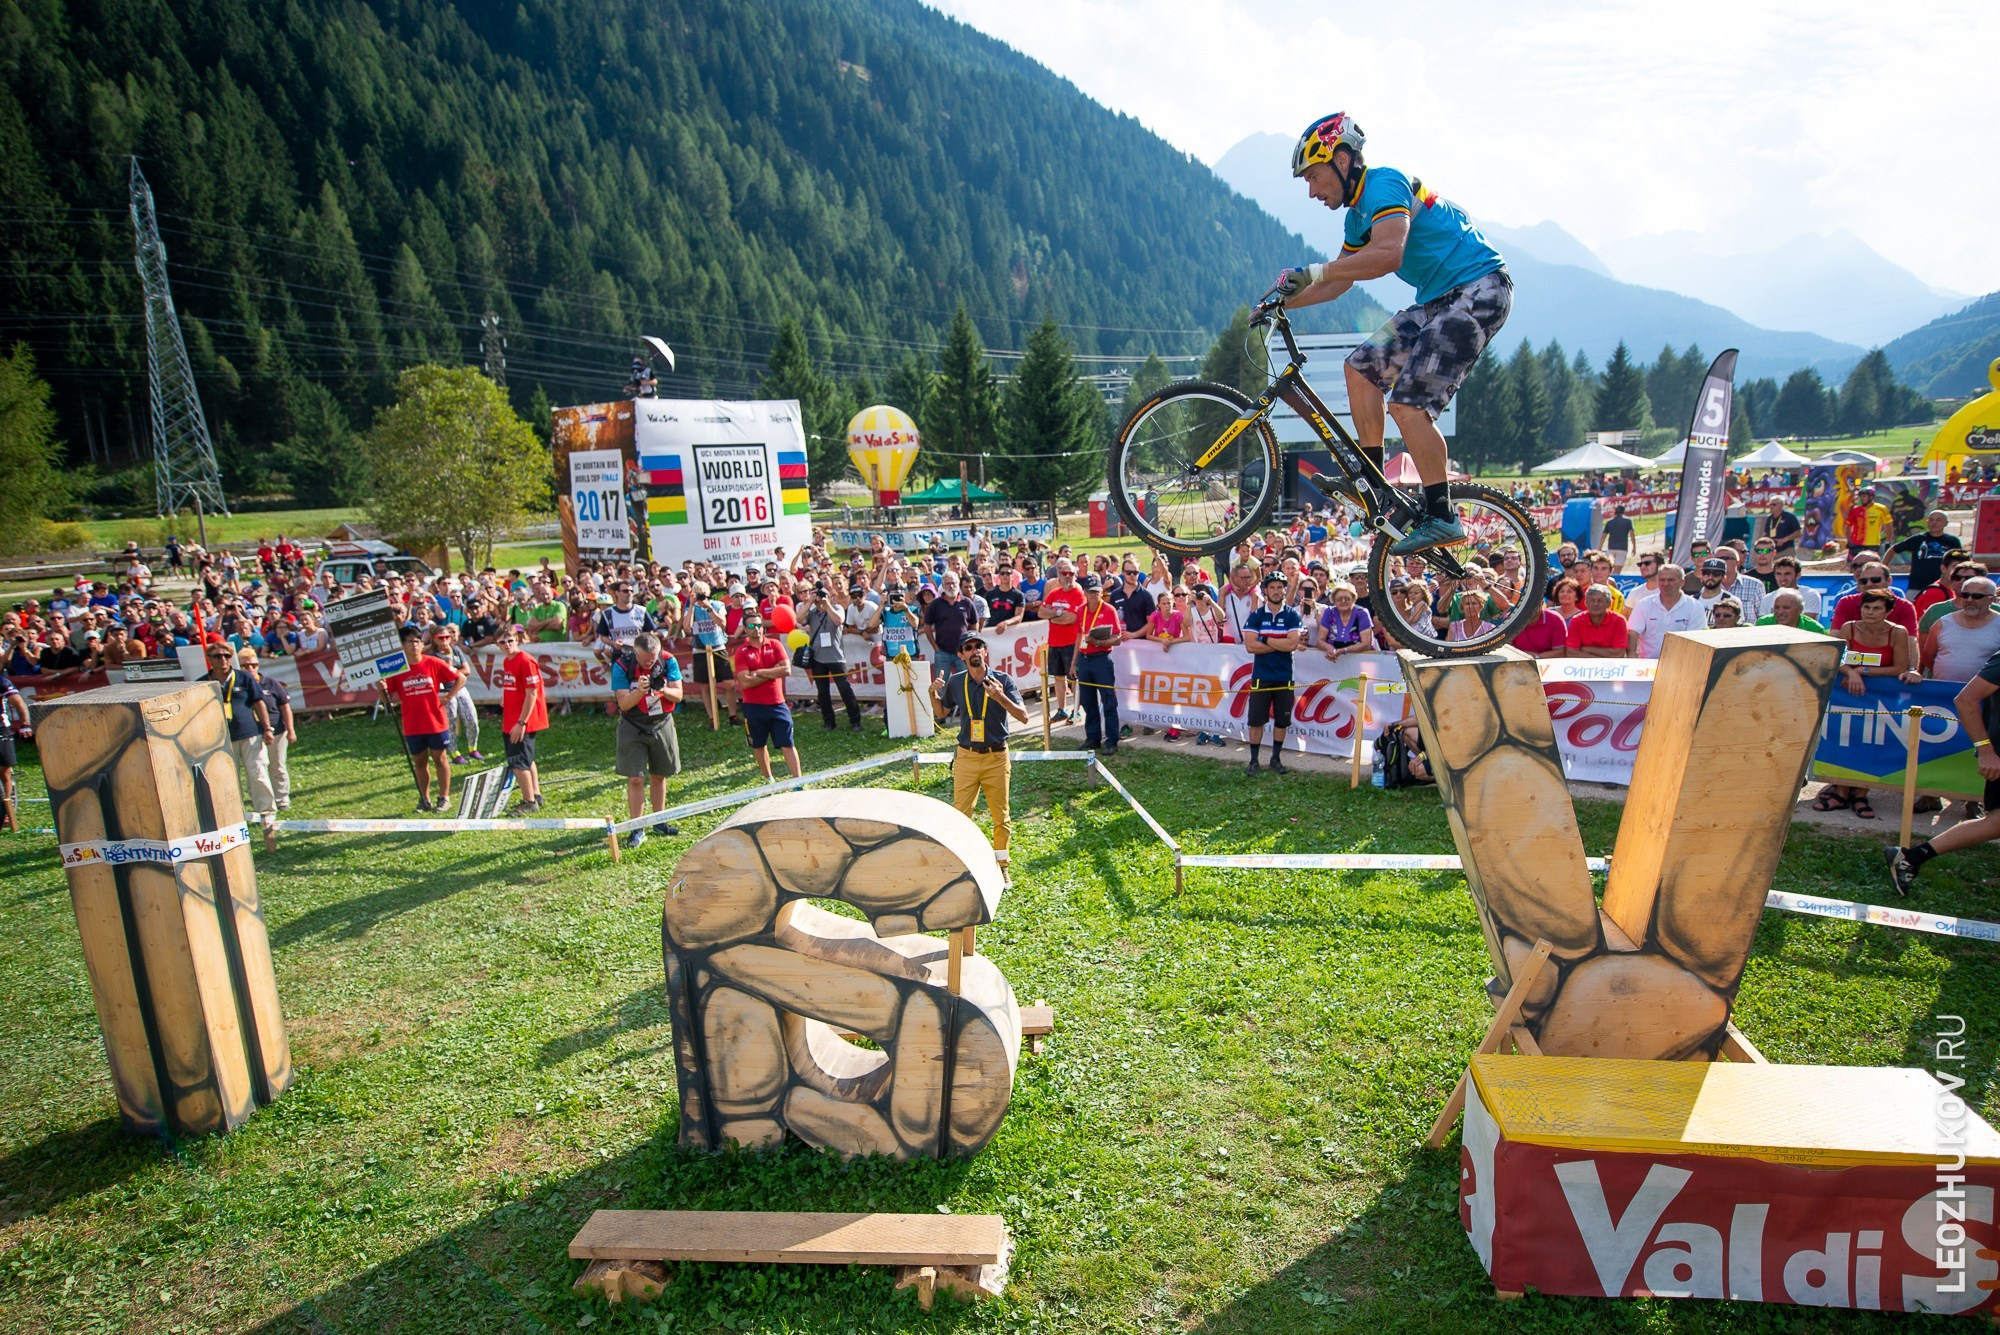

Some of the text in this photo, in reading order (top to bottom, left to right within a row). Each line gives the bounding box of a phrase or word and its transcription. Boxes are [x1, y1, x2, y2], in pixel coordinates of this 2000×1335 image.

[1702, 387, 1724, 428] 5
[864, 433, 882, 448] Val
[884, 437, 892, 446] di
[1207, 425, 1239, 459] mybike
[1697, 435, 1717, 446] UCI
[713, 449, 746, 457] MOUNTAIN
[747, 449, 760, 457] BIKE
[601, 472, 619, 482] FINALS
[702, 460, 763, 481] WORLD
[706, 483, 764, 494] CHAMPIONSHIPS
[576, 490, 620, 522] 2017
[711, 496, 767, 524] 2016
[1025, 523, 1052, 538] PEJO
[703, 532, 778, 550] DHI 4X TRIALS
[712, 552, 741, 562] MASTERS
[354, 667, 374, 679] UCI
[538, 654, 608, 689] Sole
[1143, 674, 1211, 706] IPER
[1138, 713, 1235, 731] IPERCONVENIENZA
[1287, 727, 1329, 738] GIORNI
[195, 839, 214, 854] Val
[1553, 1159, 1770, 1303] Val
[1782, 1230, 1884, 1310] di
